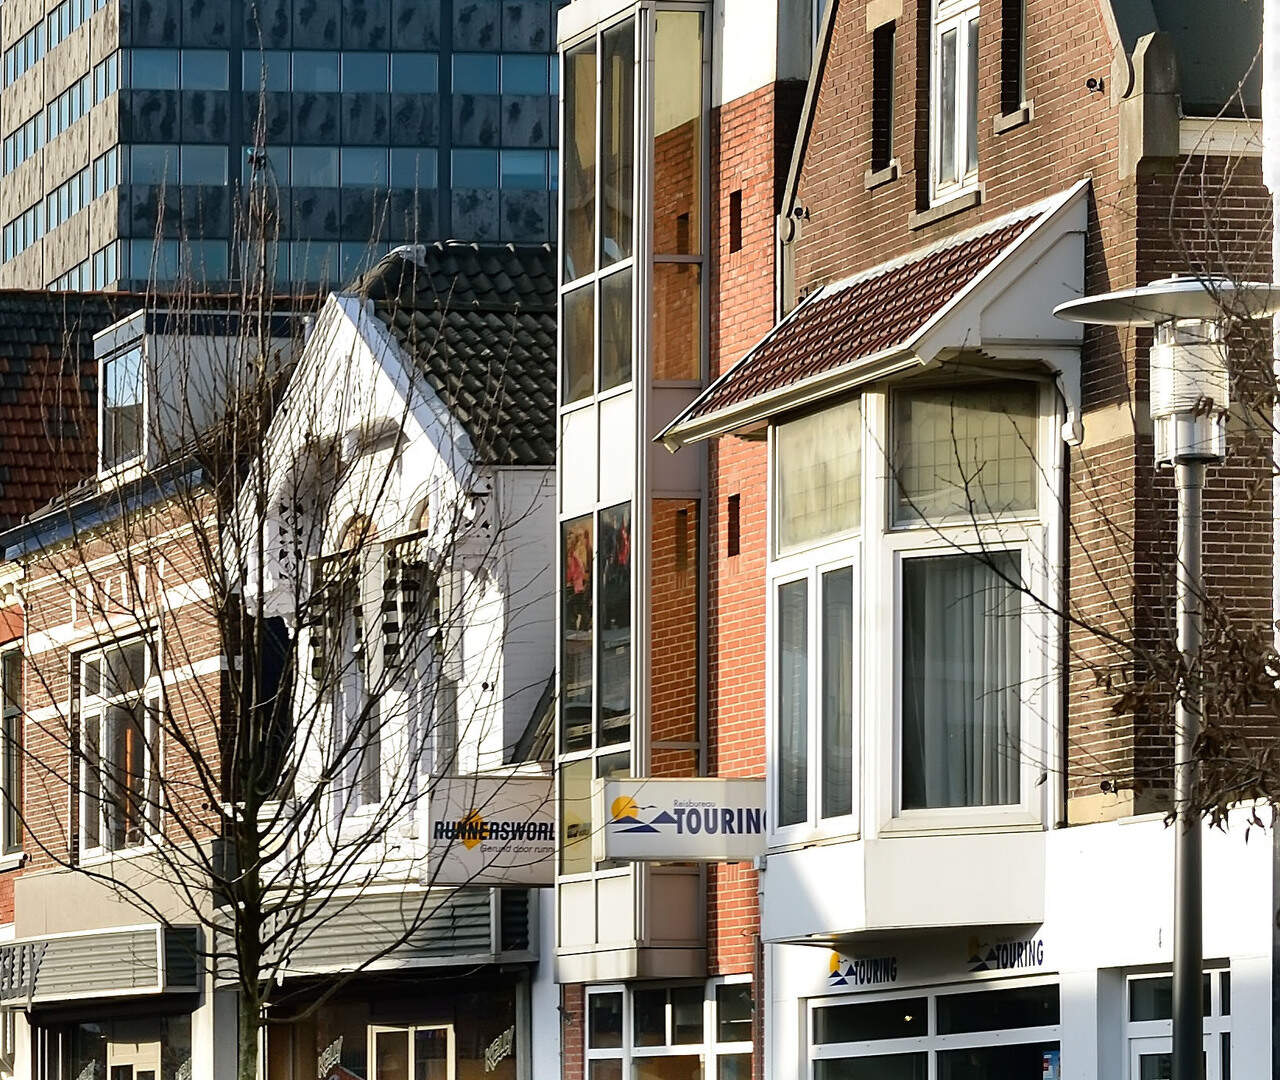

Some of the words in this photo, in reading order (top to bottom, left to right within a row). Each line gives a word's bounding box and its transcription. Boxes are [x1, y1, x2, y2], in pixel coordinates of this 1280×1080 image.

[674, 808, 767, 834] TOURIN
[513, 845, 532, 853] door
[996, 939, 1044, 969] TOURING
[854, 957, 897, 986] TOURING
